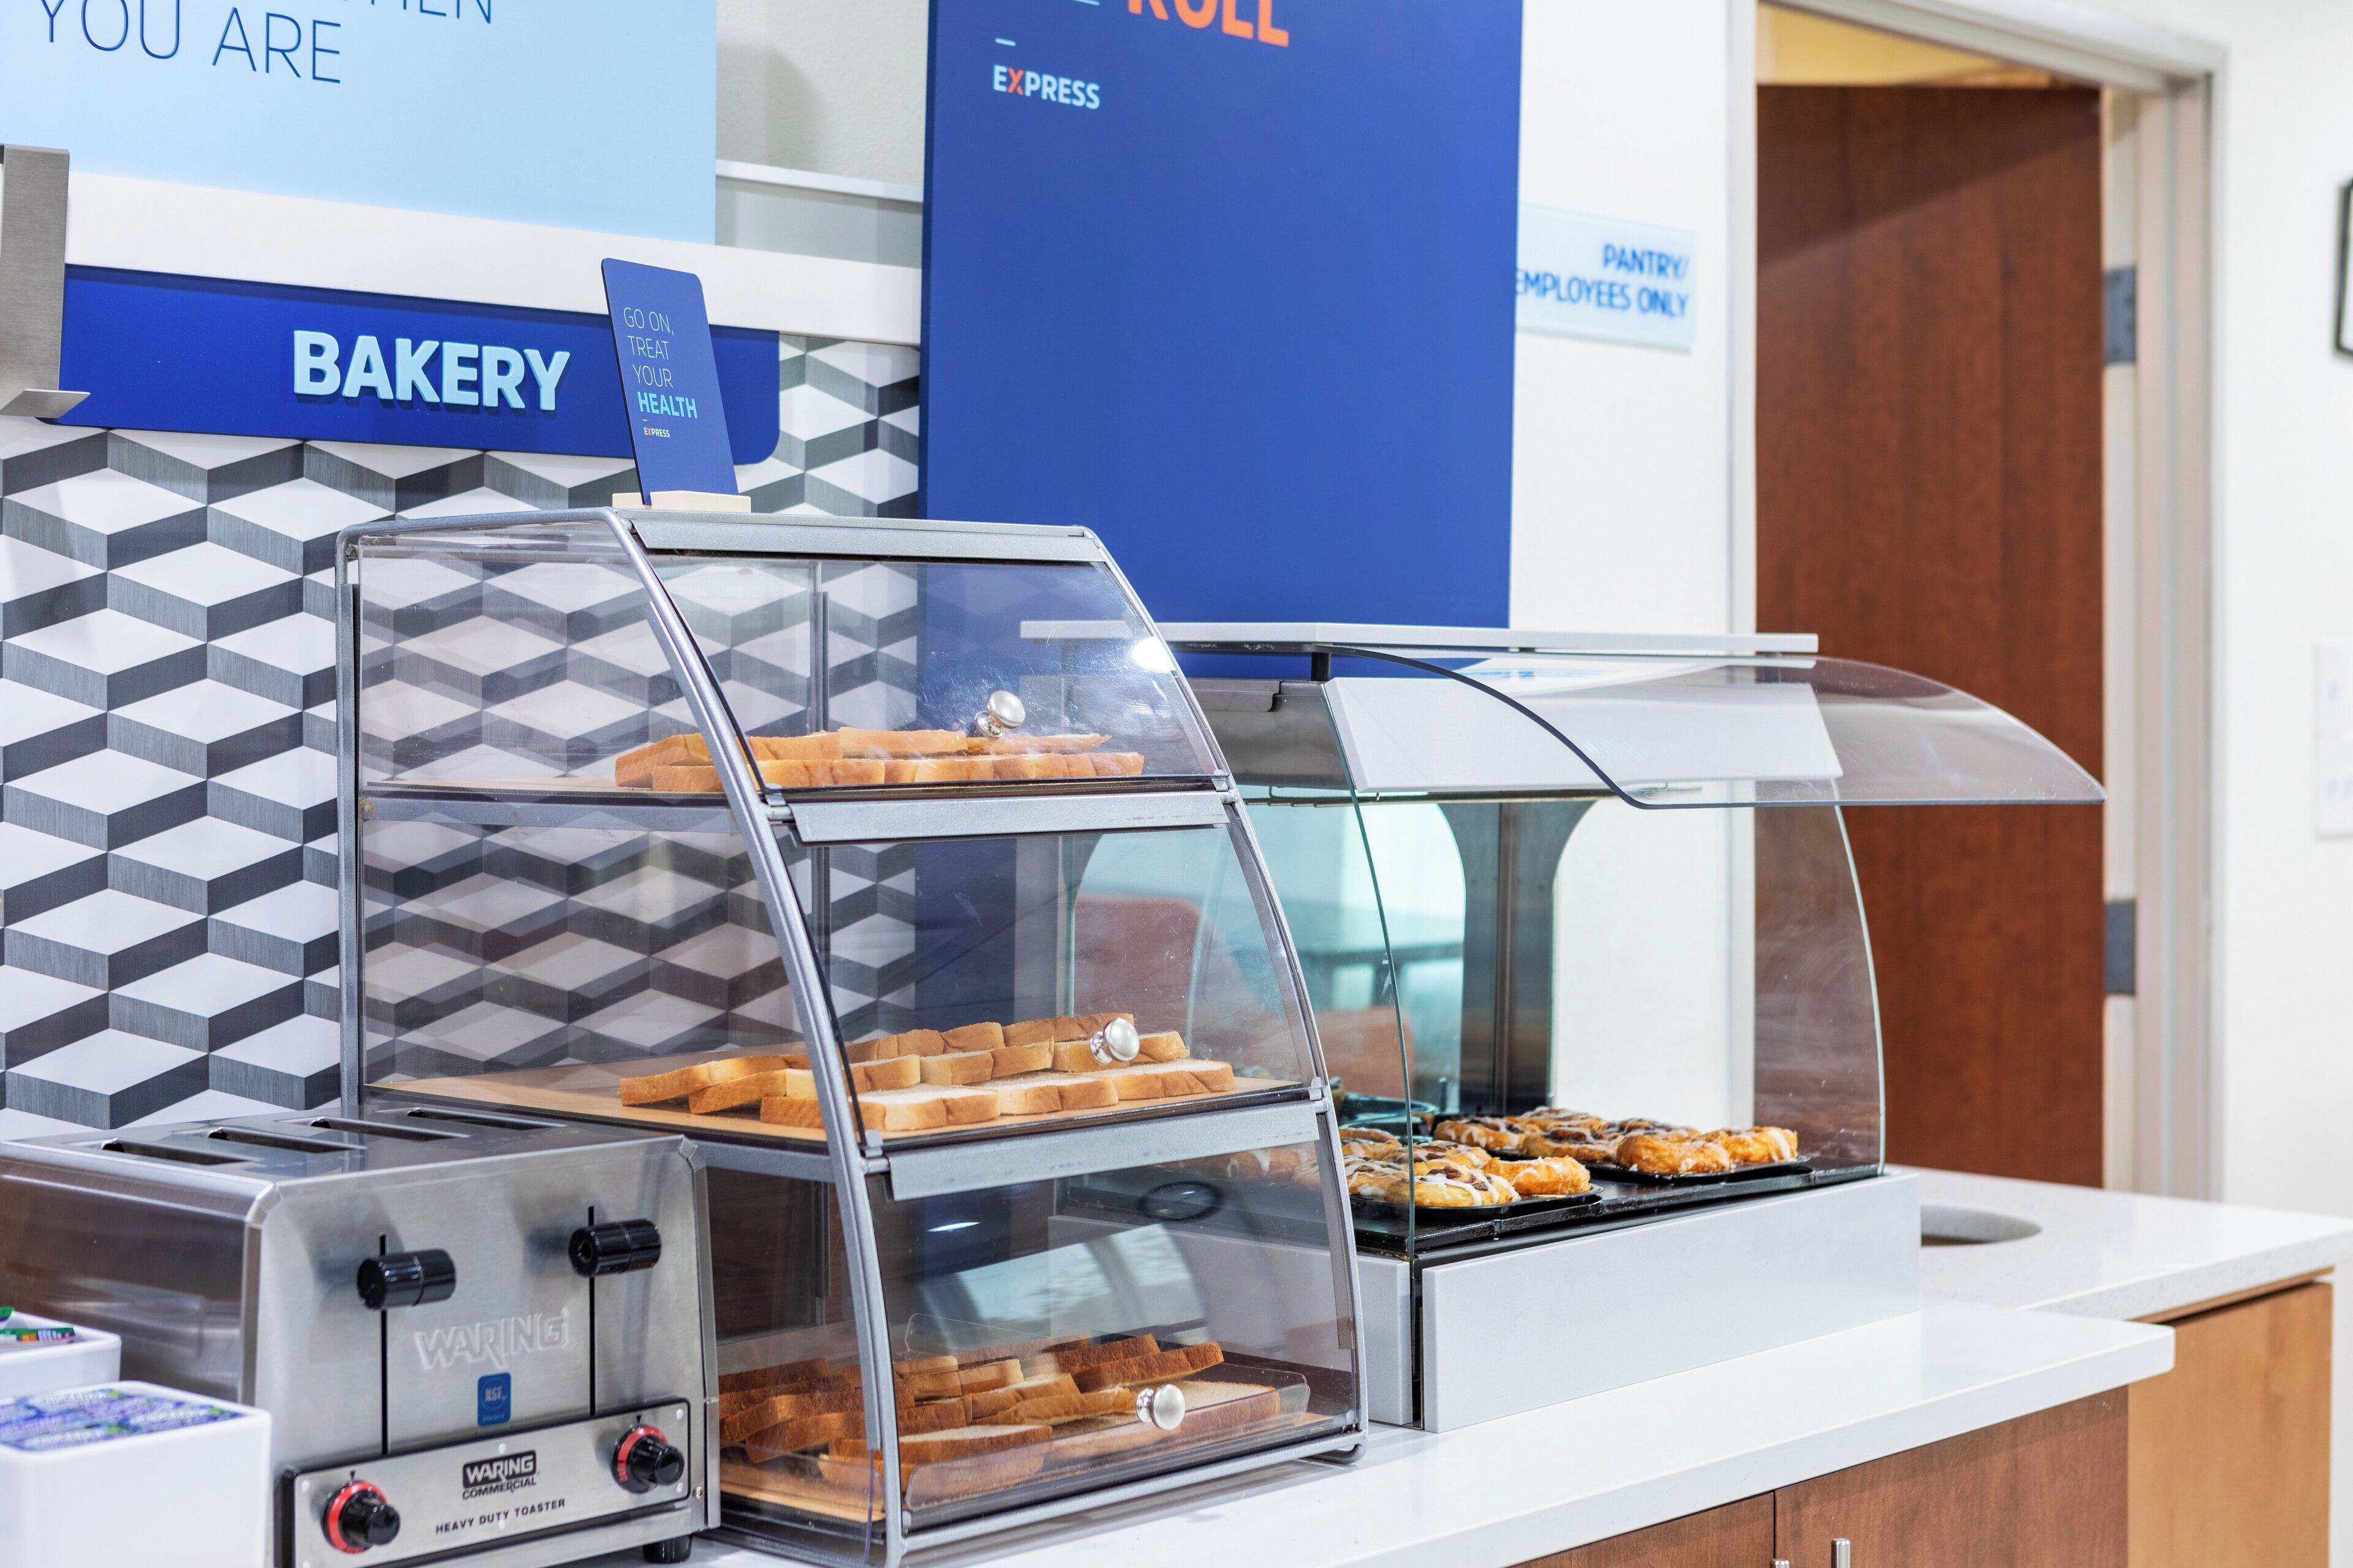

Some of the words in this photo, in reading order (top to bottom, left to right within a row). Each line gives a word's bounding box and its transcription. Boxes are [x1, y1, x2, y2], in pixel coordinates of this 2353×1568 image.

[1128, 0, 1289, 47] LL
[42, 0, 180, 59] YOU
[212, 6, 341, 84] ARE
[993, 64, 1100, 110] EXPRESS
[1637, 286, 1689, 317] ONLY
[624, 307, 644, 328] GO
[649, 311, 674, 336] ON,
[627, 335, 669, 360] TREAT
[294, 330, 571, 411] BAKERY
[632, 364, 673, 388] YOUR
[637, 391, 698, 419] HEALTH
[643, 427, 670, 437] EXPRESS
[414, 1311, 569, 1370] WARING
[466, 1455, 534, 1483] WARING
[463, 1476, 537, 1499] COMMERCIAL
[436, 1518, 474, 1534] HEAVY
[479, 1510, 510, 1524] DUTY
[515, 1498, 566, 1517] TOASTER
